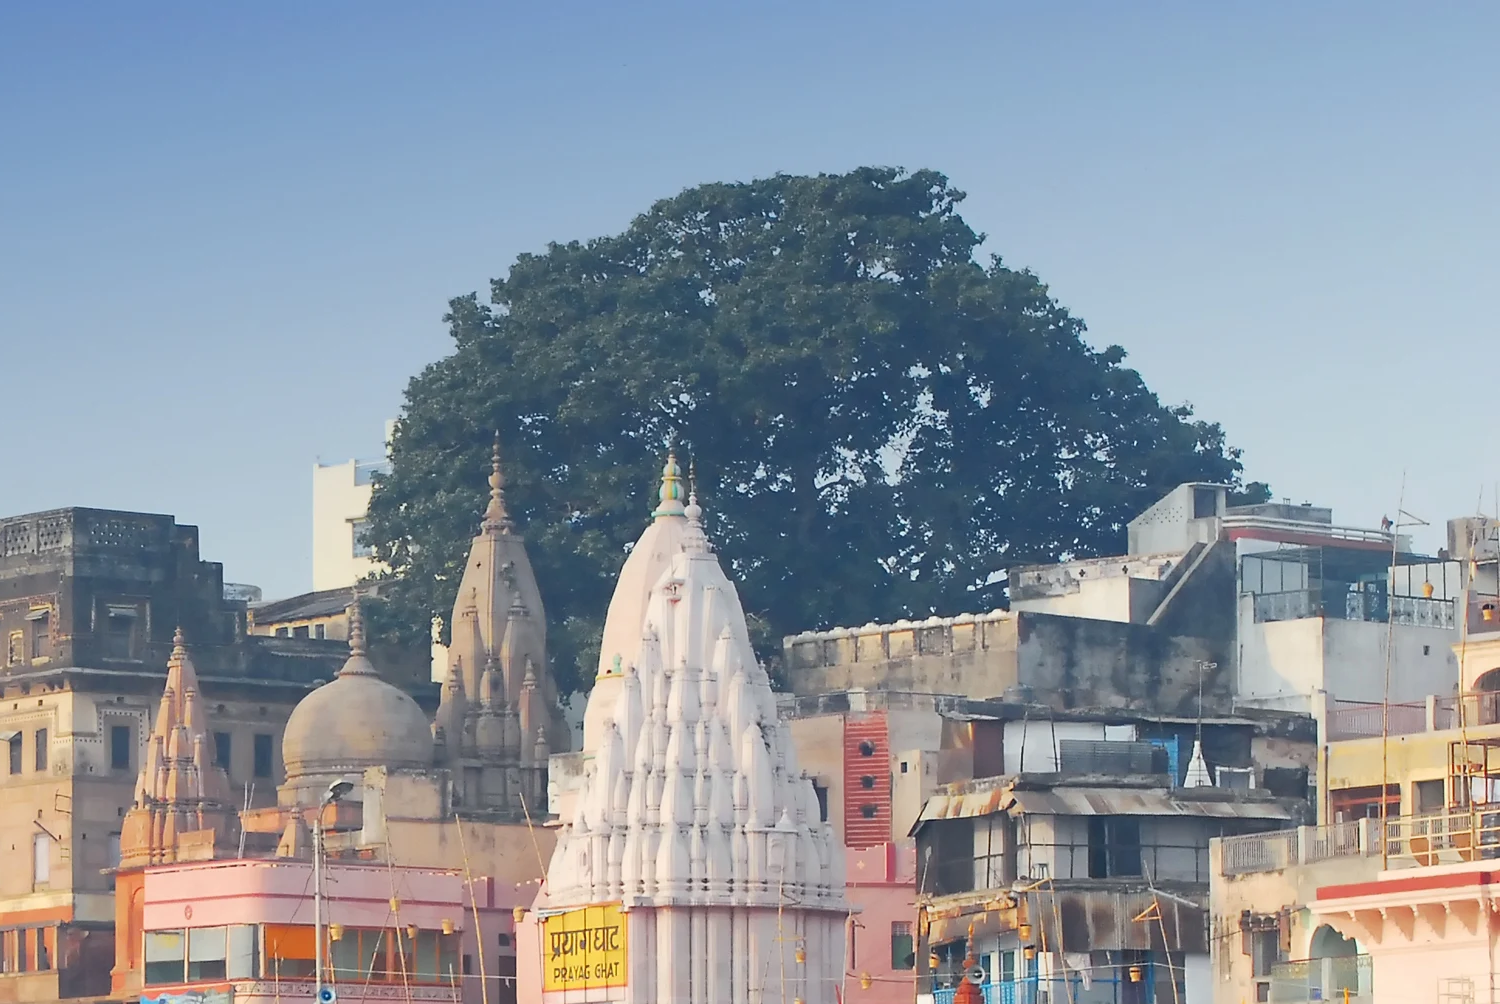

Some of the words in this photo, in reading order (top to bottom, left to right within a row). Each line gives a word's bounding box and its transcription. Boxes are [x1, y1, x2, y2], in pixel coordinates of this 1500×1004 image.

[550, 928, 593, 962] प्रयाग
[594, 925, 619, 952] घाट
[553, 964, 590, 983] PRAYAG
[594, 961, 619, 980] GHAT
